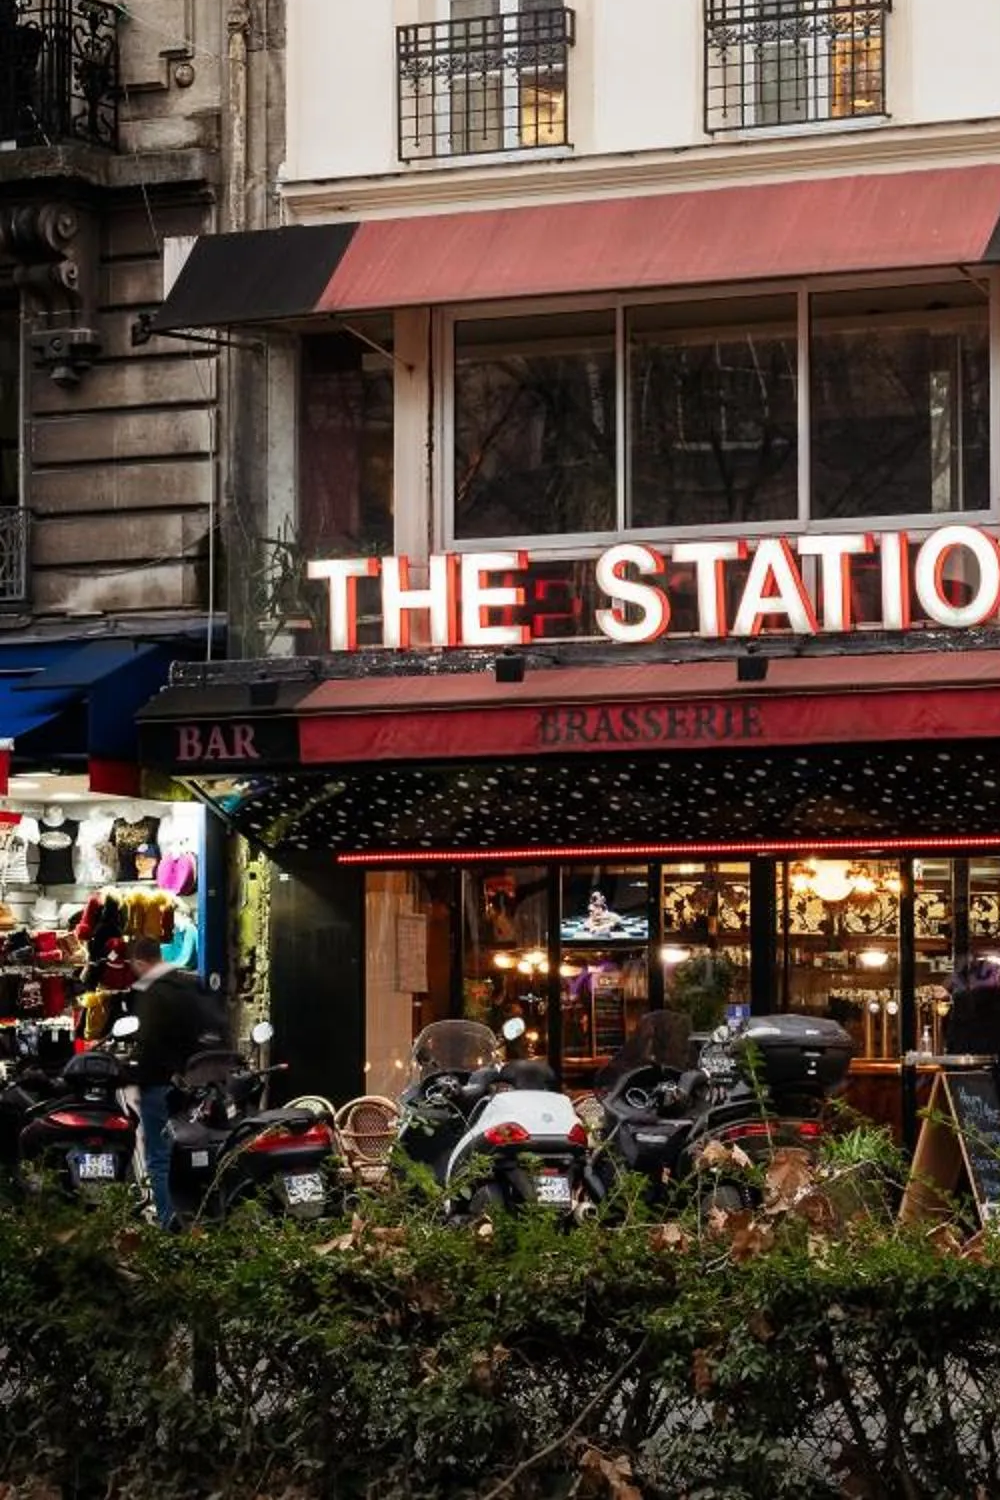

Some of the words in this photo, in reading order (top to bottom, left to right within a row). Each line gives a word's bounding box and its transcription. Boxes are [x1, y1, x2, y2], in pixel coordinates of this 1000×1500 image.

[308, 550, 532, 651] THE
[174, 724, 260, 761] BAR
[539, 702, 764, 744] BRASSERIE
